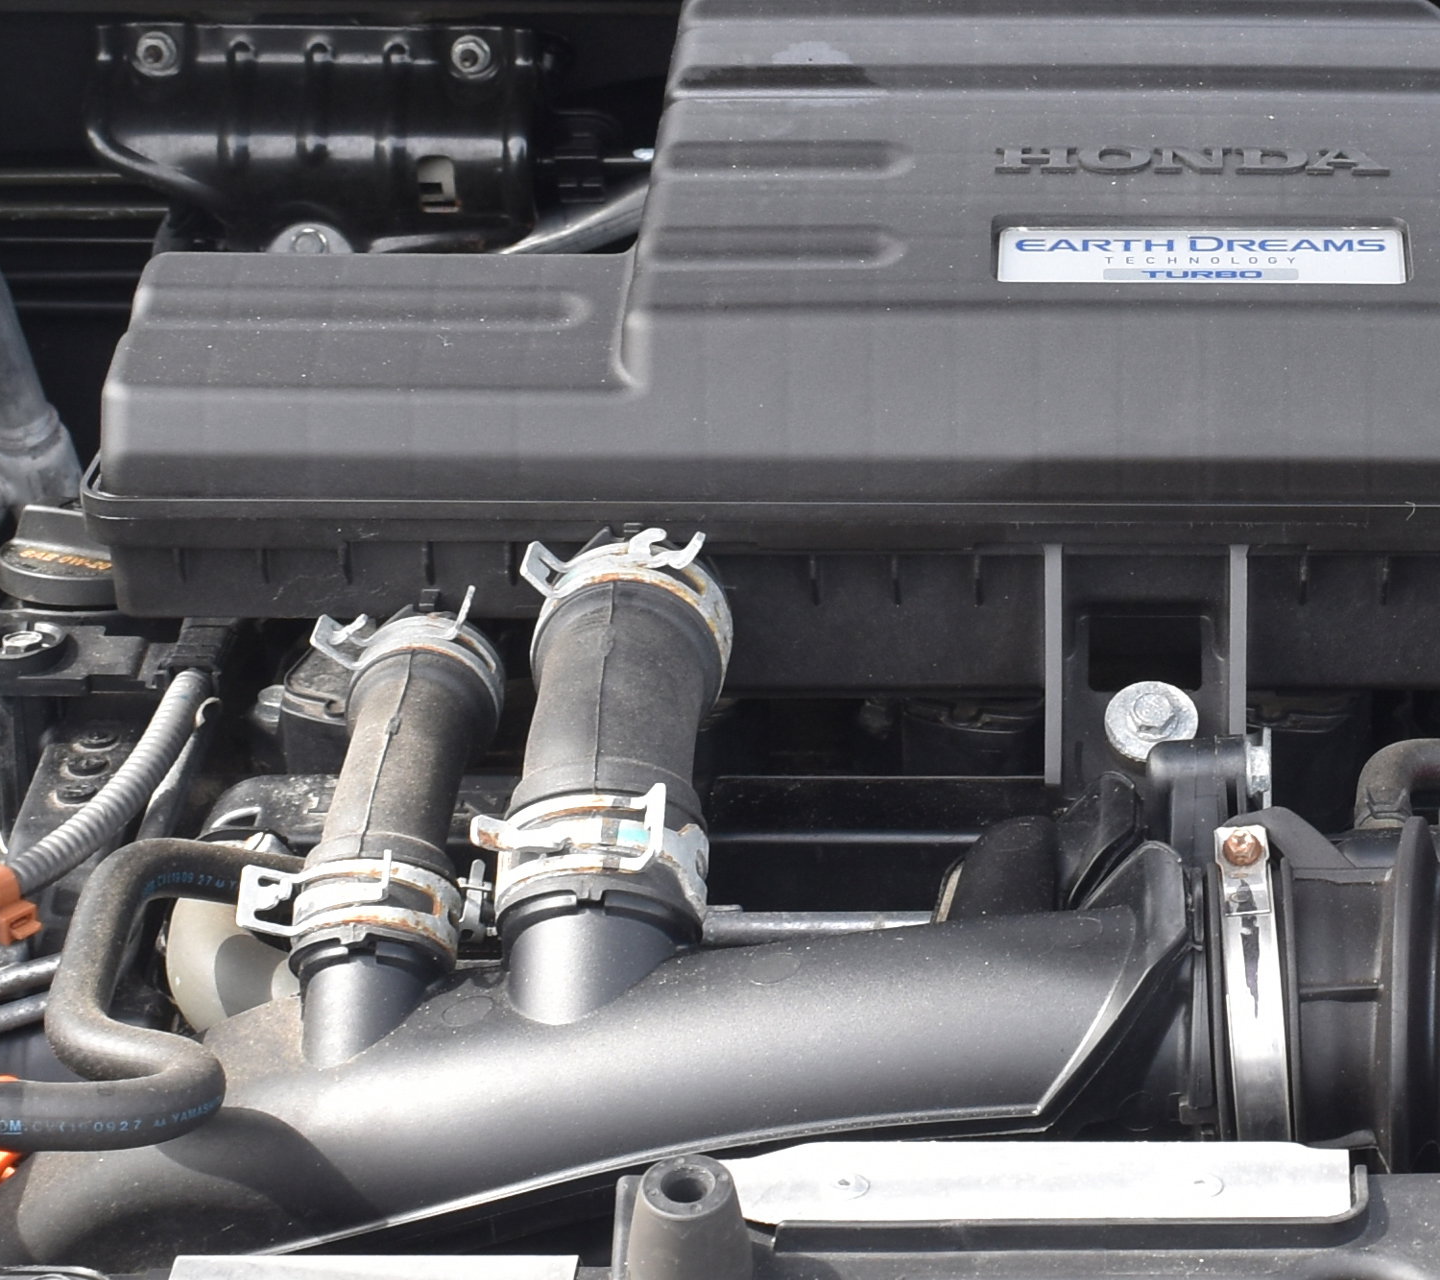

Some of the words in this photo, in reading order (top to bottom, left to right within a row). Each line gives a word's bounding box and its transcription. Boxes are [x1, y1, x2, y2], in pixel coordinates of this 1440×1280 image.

[994, 144, 1391, 176] HONDA
[1015, 236, 1175, 253] EARTH
[1189, 234, 1387, 253] DREAMS
[1104, 255, 1298, 266] TECHNOLOGY
[1141, 268, 1264, 280] TURBO
